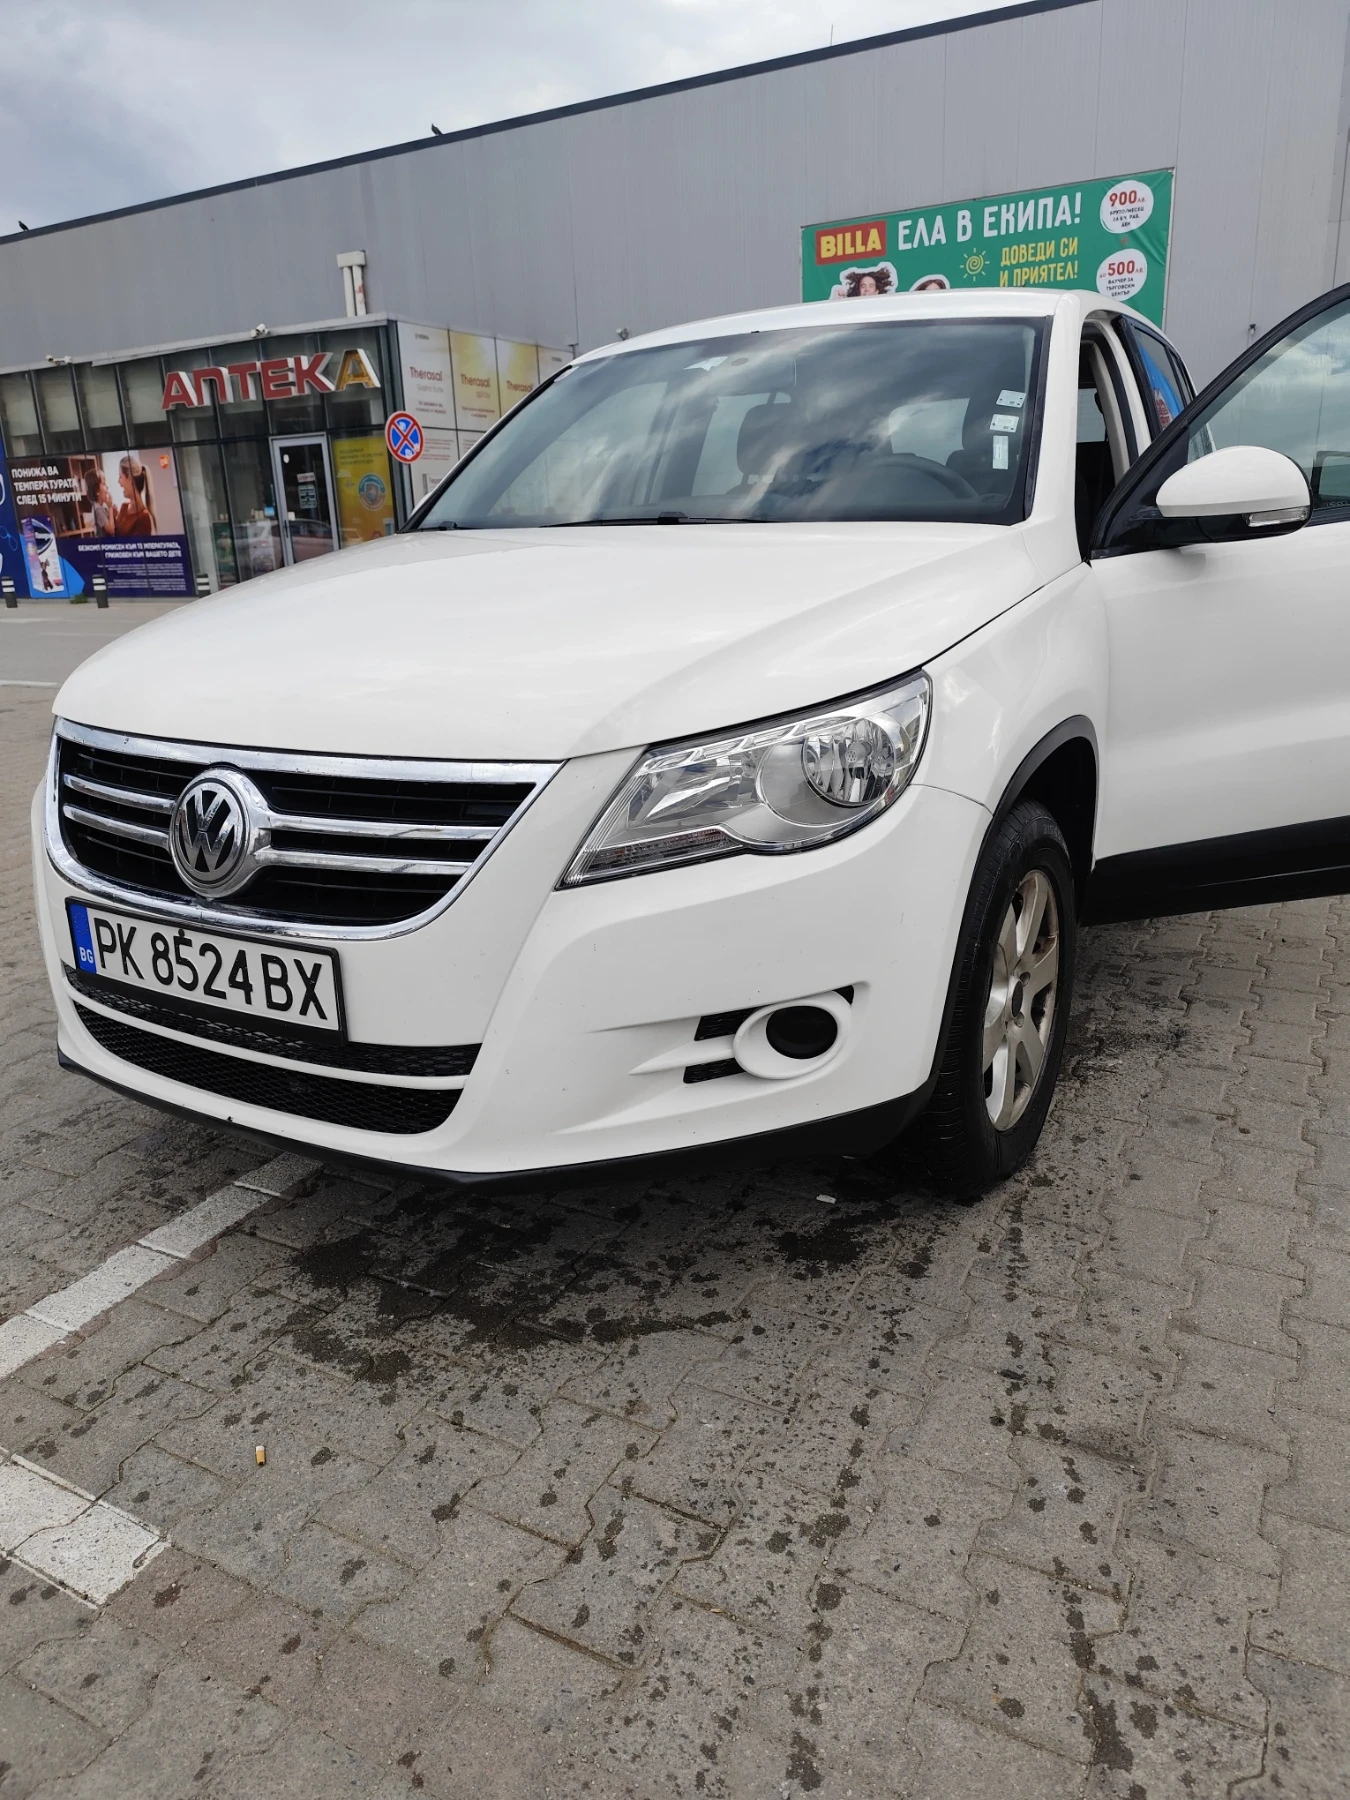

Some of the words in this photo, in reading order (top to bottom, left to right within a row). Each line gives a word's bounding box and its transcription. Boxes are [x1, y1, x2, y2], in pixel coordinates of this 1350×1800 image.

[1109, 190, 1137, 207] 900
[898, 215, 947, 251] ЕЛА
[956, 209, 973, 243] В
[983, 191, 1082, 237] ЕКИПА!
[820, 228, 882, 258] BILLA
[1000, 240, 1055, 267] ДОВЕДИ
[1060, 236, 1078, 258] СИ
[1000, 269, 1009, 287] И
[1012, 260, 1078, 287] ПРИЯТЕЛ!
[1107, 260, 1135, 276] 500
[1106, 283, 1135, 291] ТЪРГОВСКИ
[162, 348, 381, 410] АПТЕКА
[16, 494, 38, 506] СЛЕД
[38, 494, 46, 504] 15
[79, 946, 95, 964] BG
[93, 917, 145, 980] PK
[150, 930, 254, 1006] 8524
[260, 953, 328, 1021] BX
